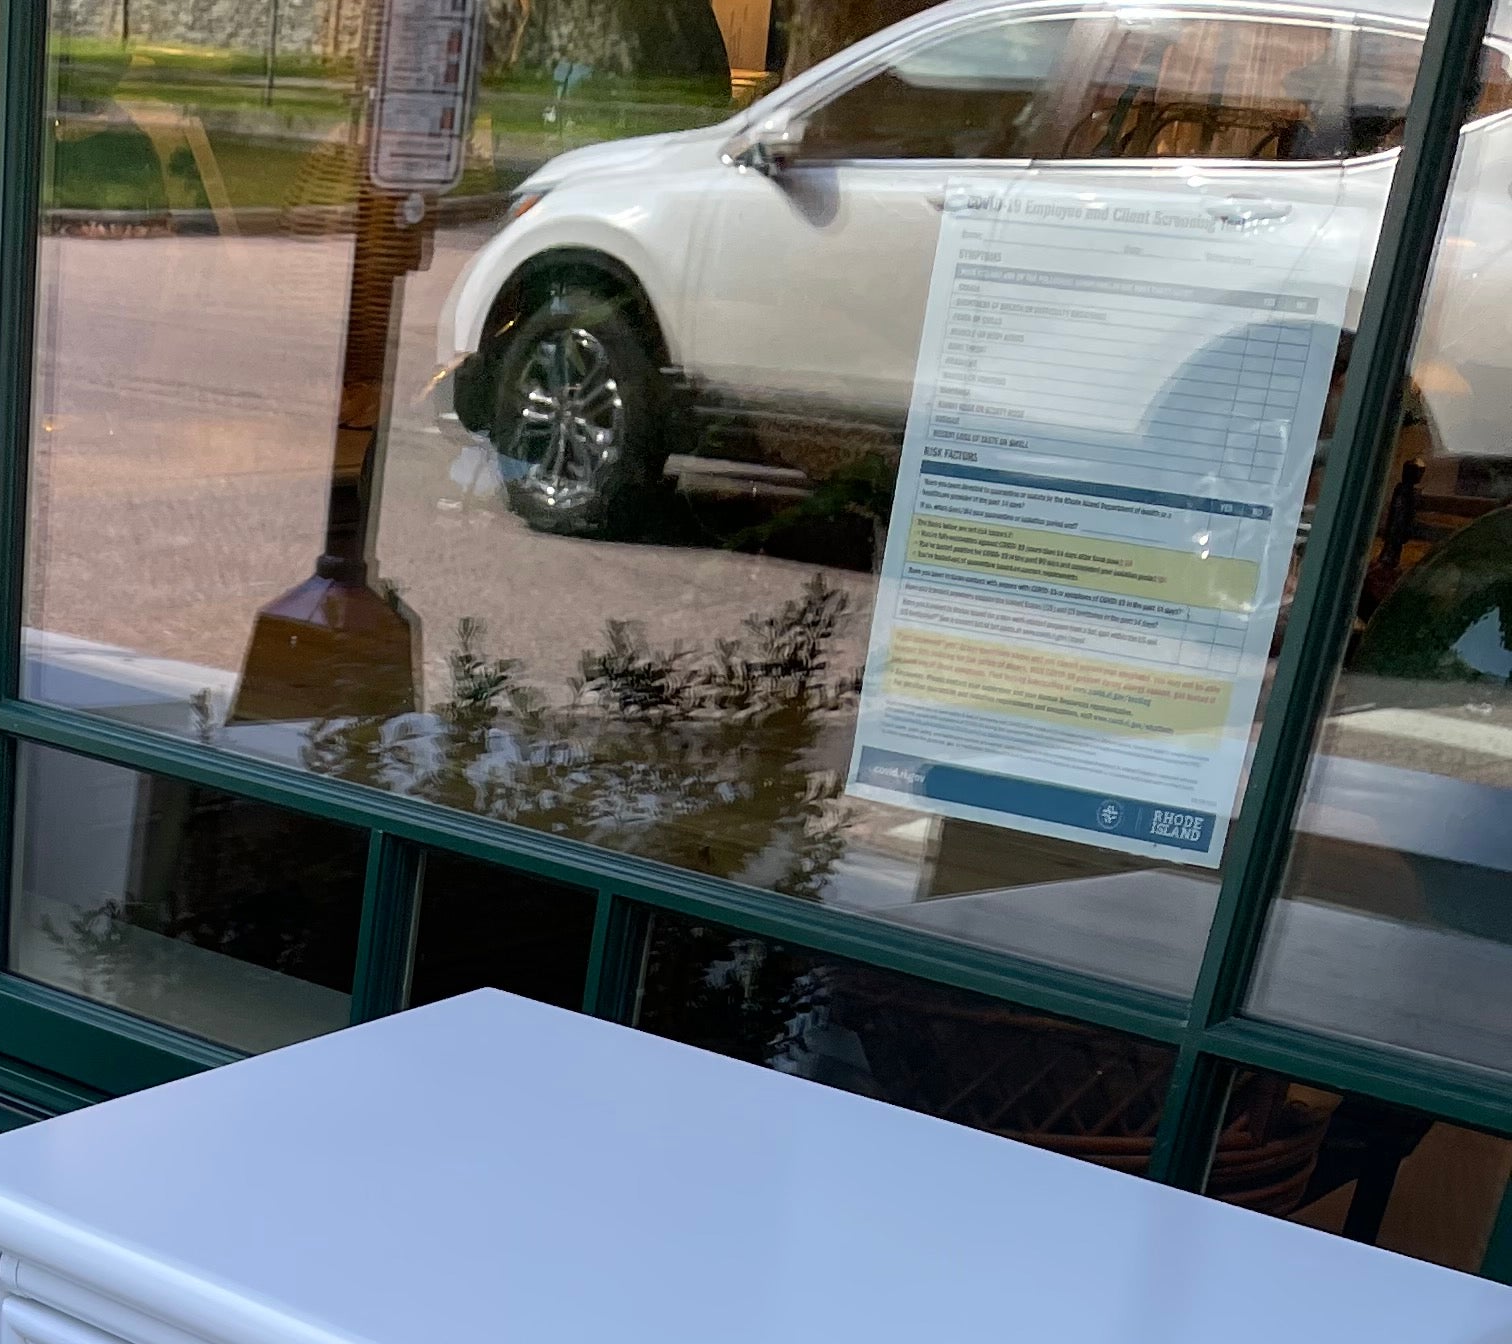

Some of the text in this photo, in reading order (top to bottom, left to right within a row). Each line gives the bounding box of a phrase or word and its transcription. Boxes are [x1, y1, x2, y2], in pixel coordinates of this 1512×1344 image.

[1023, 198, 1083, 221] Employee
[1084, 203, 1110, 222] and
[1111, 205, 1152, 225] Client
[1151, 209, 1219, 234] Screening
[922, 445, 979, 462] RISK FACTORS
[871, 762, 927, 787] covid.ri.gov
[1151, 808, 1204, 831] RHODE
[1148, 821, 1202, 843] ISLAND
